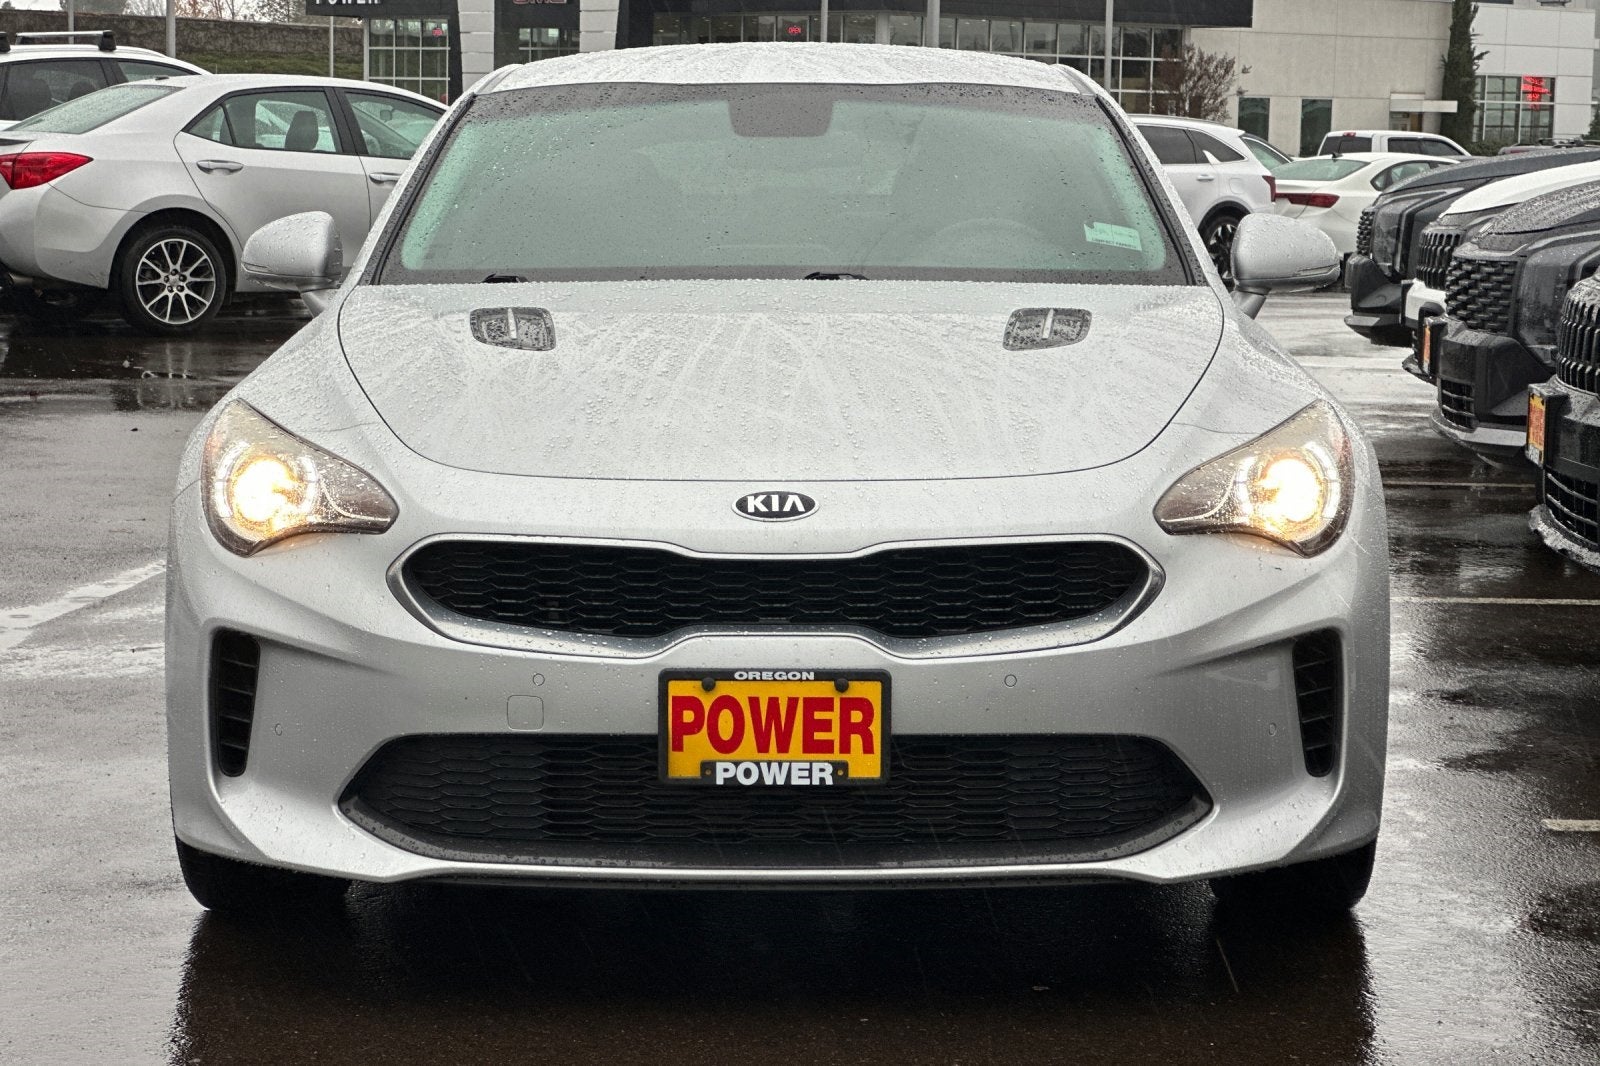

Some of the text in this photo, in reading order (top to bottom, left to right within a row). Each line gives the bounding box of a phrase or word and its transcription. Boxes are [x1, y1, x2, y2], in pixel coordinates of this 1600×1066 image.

[747, 494, 806, 513] KIA
[734, 671, 815, 680] OREGON
[671, 695, 875, 754] POWER
[715, 762, 834, 785] POWER
